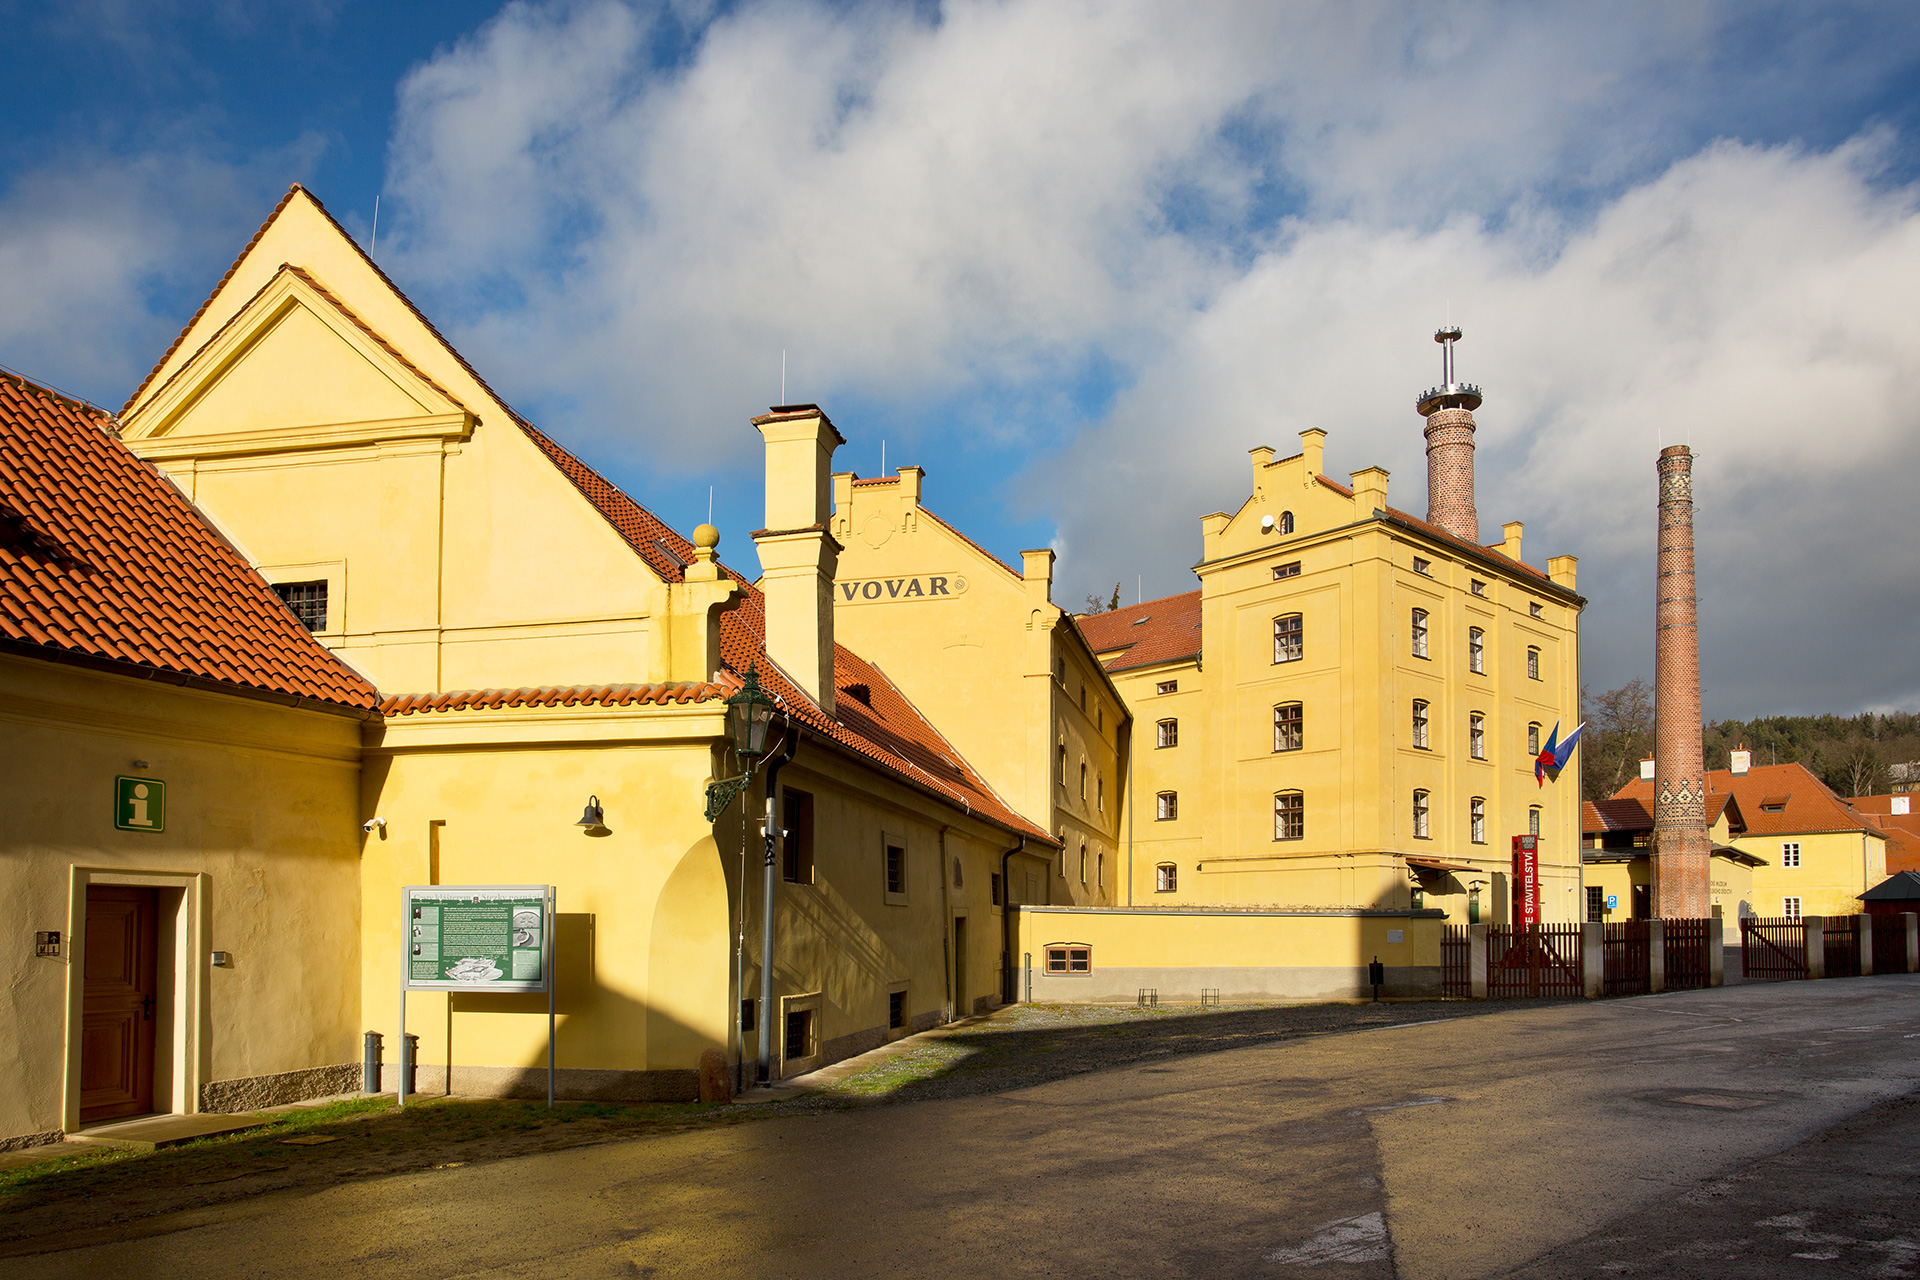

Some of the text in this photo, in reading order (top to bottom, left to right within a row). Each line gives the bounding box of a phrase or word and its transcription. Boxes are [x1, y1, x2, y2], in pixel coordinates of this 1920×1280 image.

[833, 576, 950, 602] VOVAR
[1522, 851, 1534, 914] STAVITELSTVÍ
[1609, 896, 1616, 905] P
